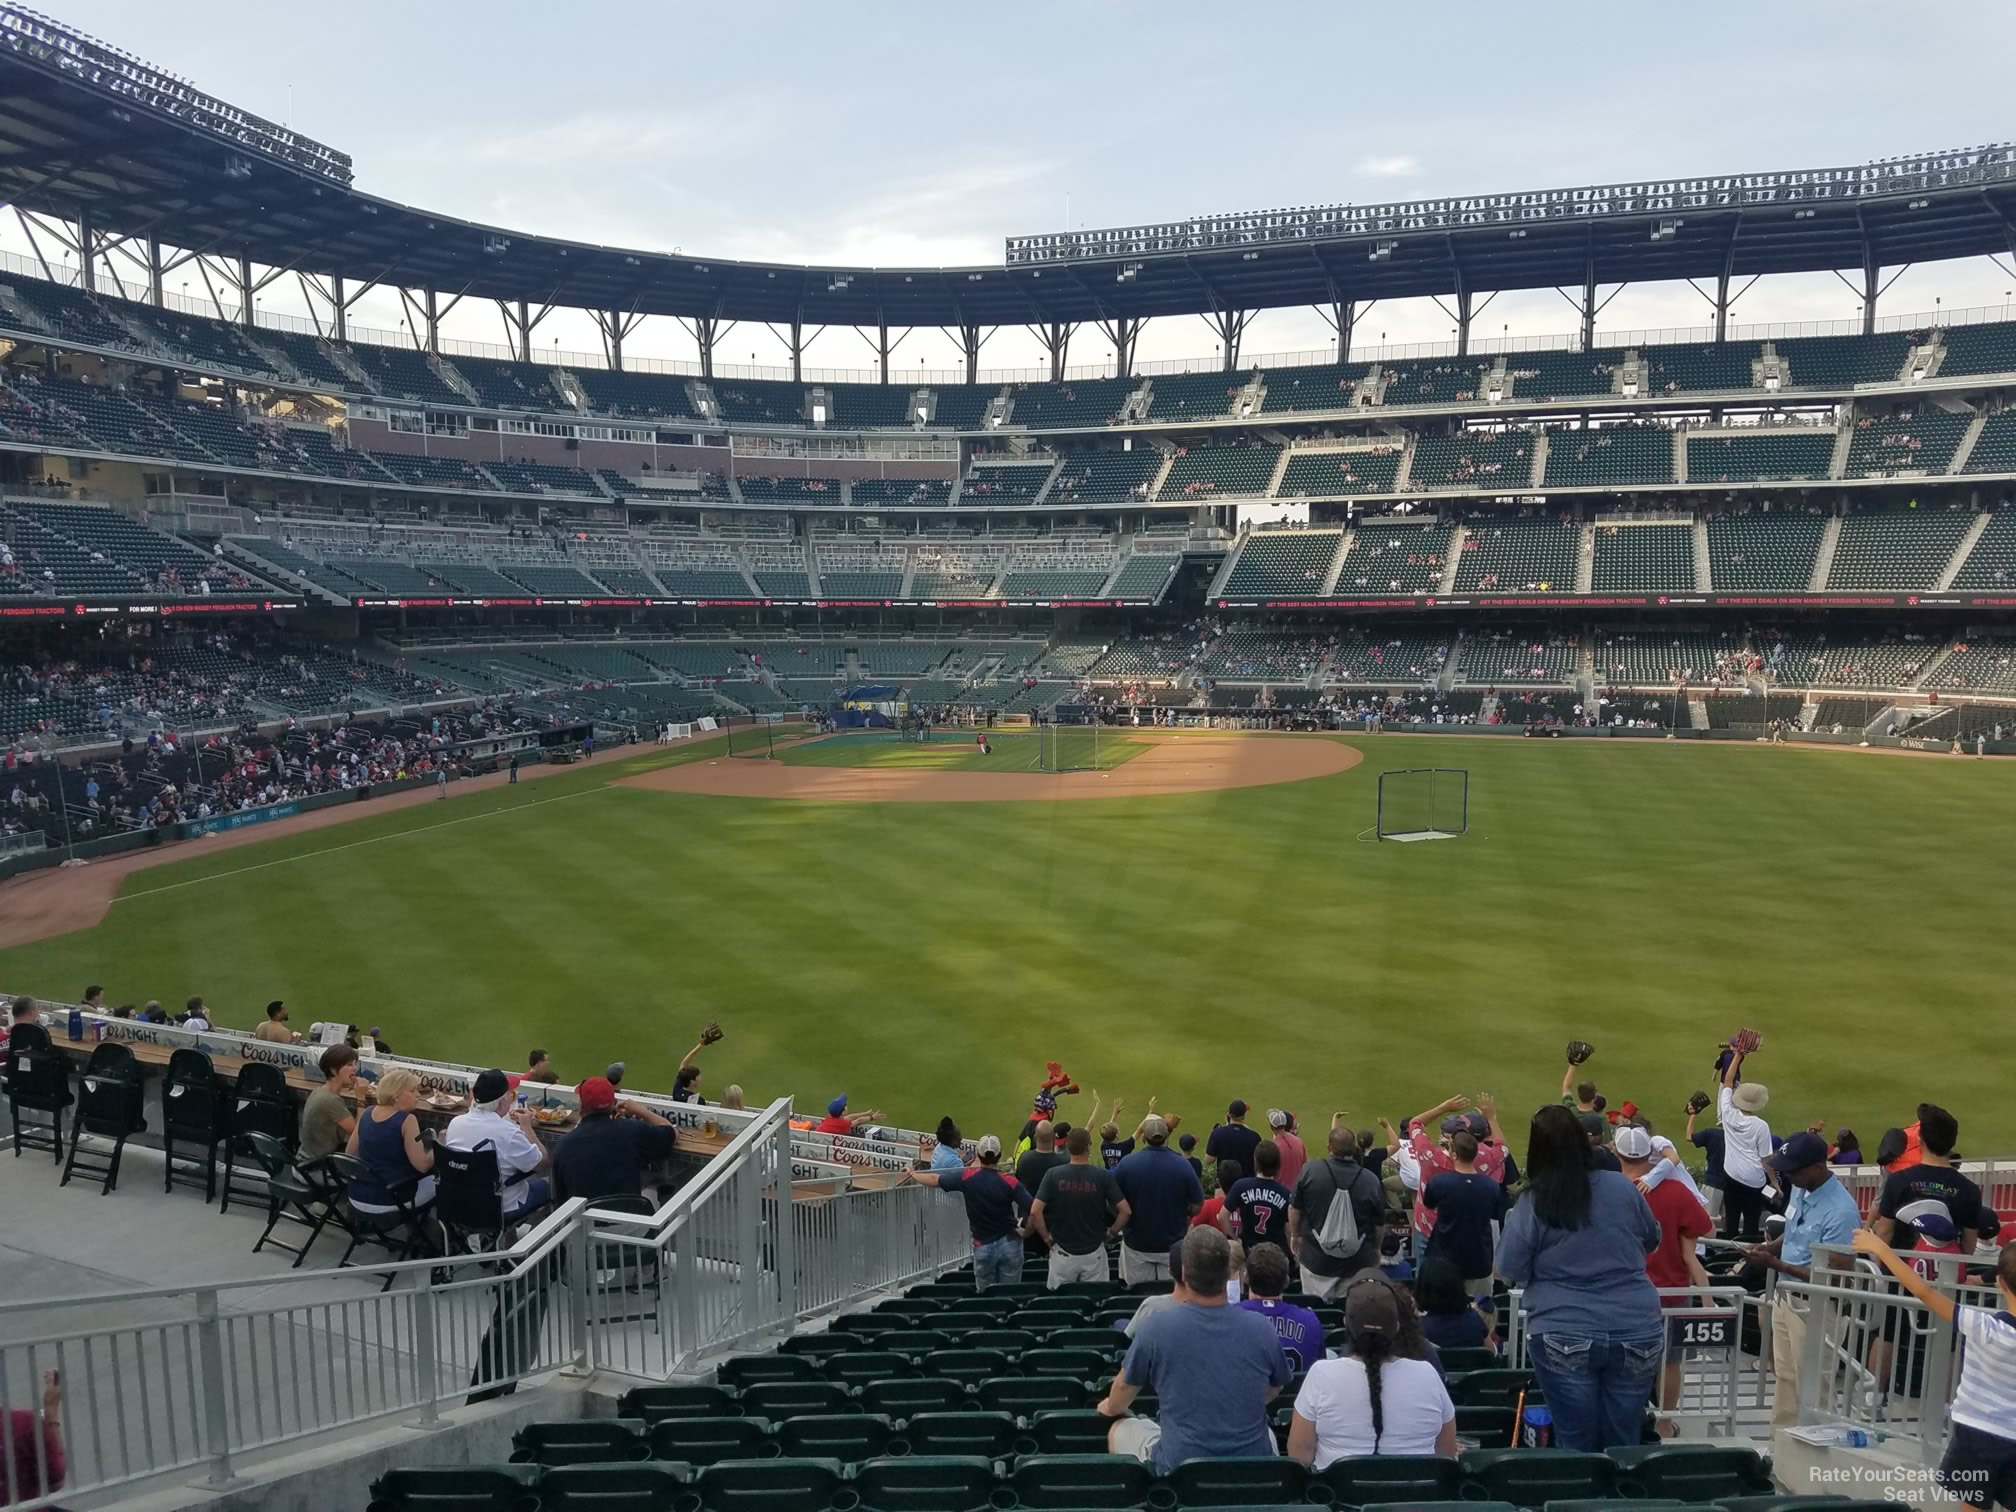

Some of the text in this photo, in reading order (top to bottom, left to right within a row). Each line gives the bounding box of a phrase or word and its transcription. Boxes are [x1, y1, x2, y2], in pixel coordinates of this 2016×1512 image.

[127, 1028, 158, 1044] LIGHT
[240, 1042, 280, 1065] Coors
[832, 1135, 896, 1156] Coors LIGHT
[833, 1147, 907, 1172] Coors LIGHT
[1057, 1179, 1098, 1193] CANADA
[1909, 1180, 1960, 1195] COLDPLAY
[1240, 1187, 1287, 1210] SWANSON
[1253, 1205, 1272, 1235] 7
[1683, 1322, 1725, 1343] 155
